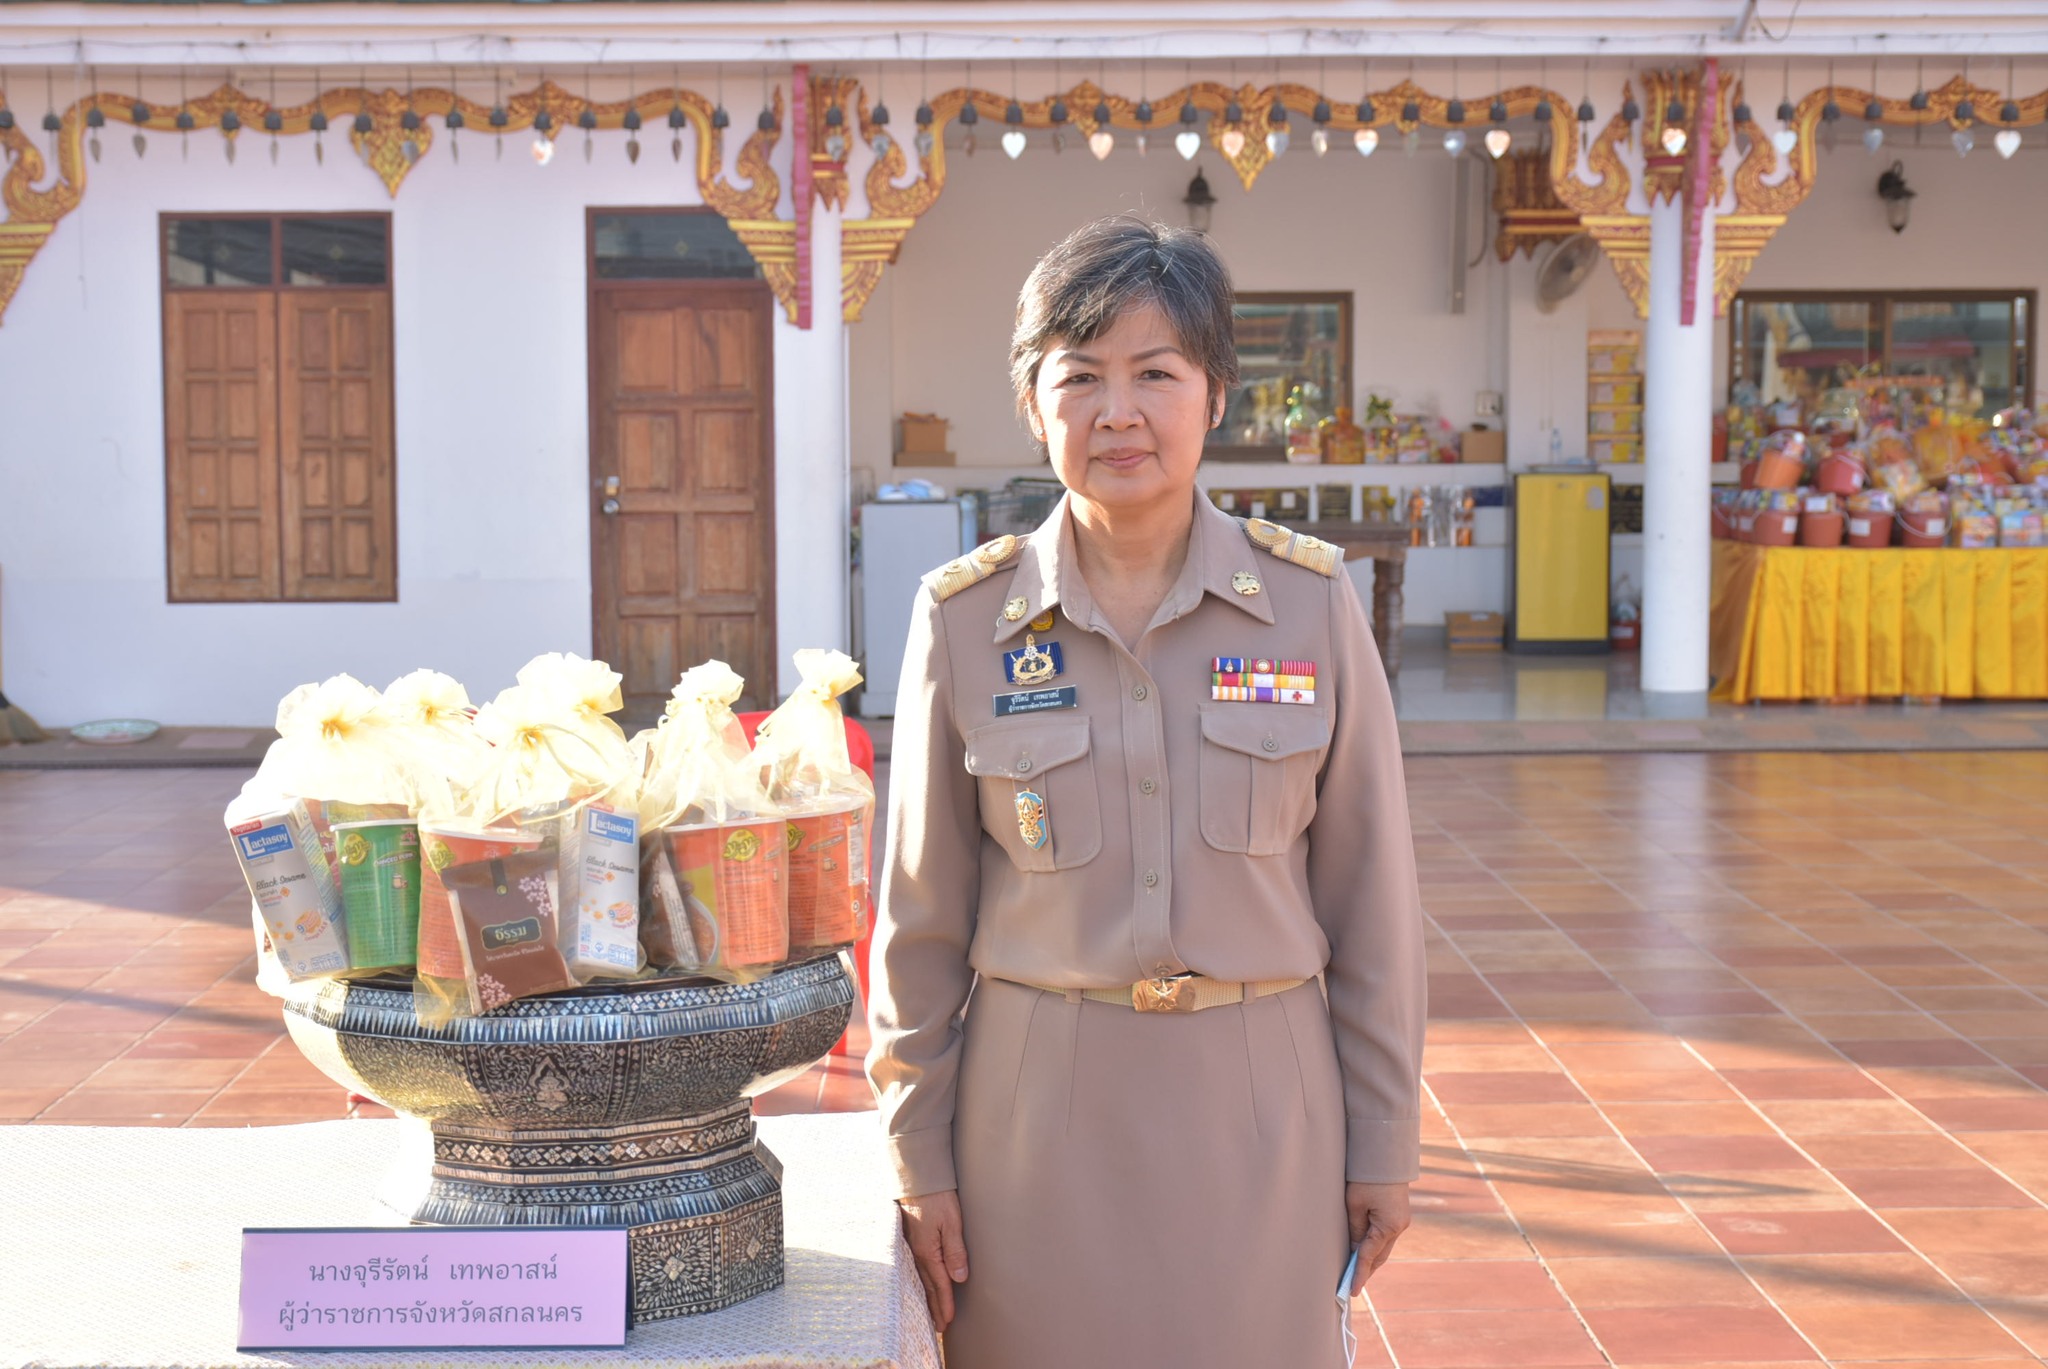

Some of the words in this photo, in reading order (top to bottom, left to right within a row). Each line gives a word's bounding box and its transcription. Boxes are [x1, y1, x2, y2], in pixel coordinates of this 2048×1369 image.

[590, 812, 632, 837] Lactasoy
[241, 831, 288, 854] Lactasoy
[309, 1254, 429, 1287] นางจุรีรัตน์
[449, 1254, 558, 1281] เทพอาสน์
[278, 1300, 583, 1332] ผู้ว่าราชการจังหวัดสกลนคร
